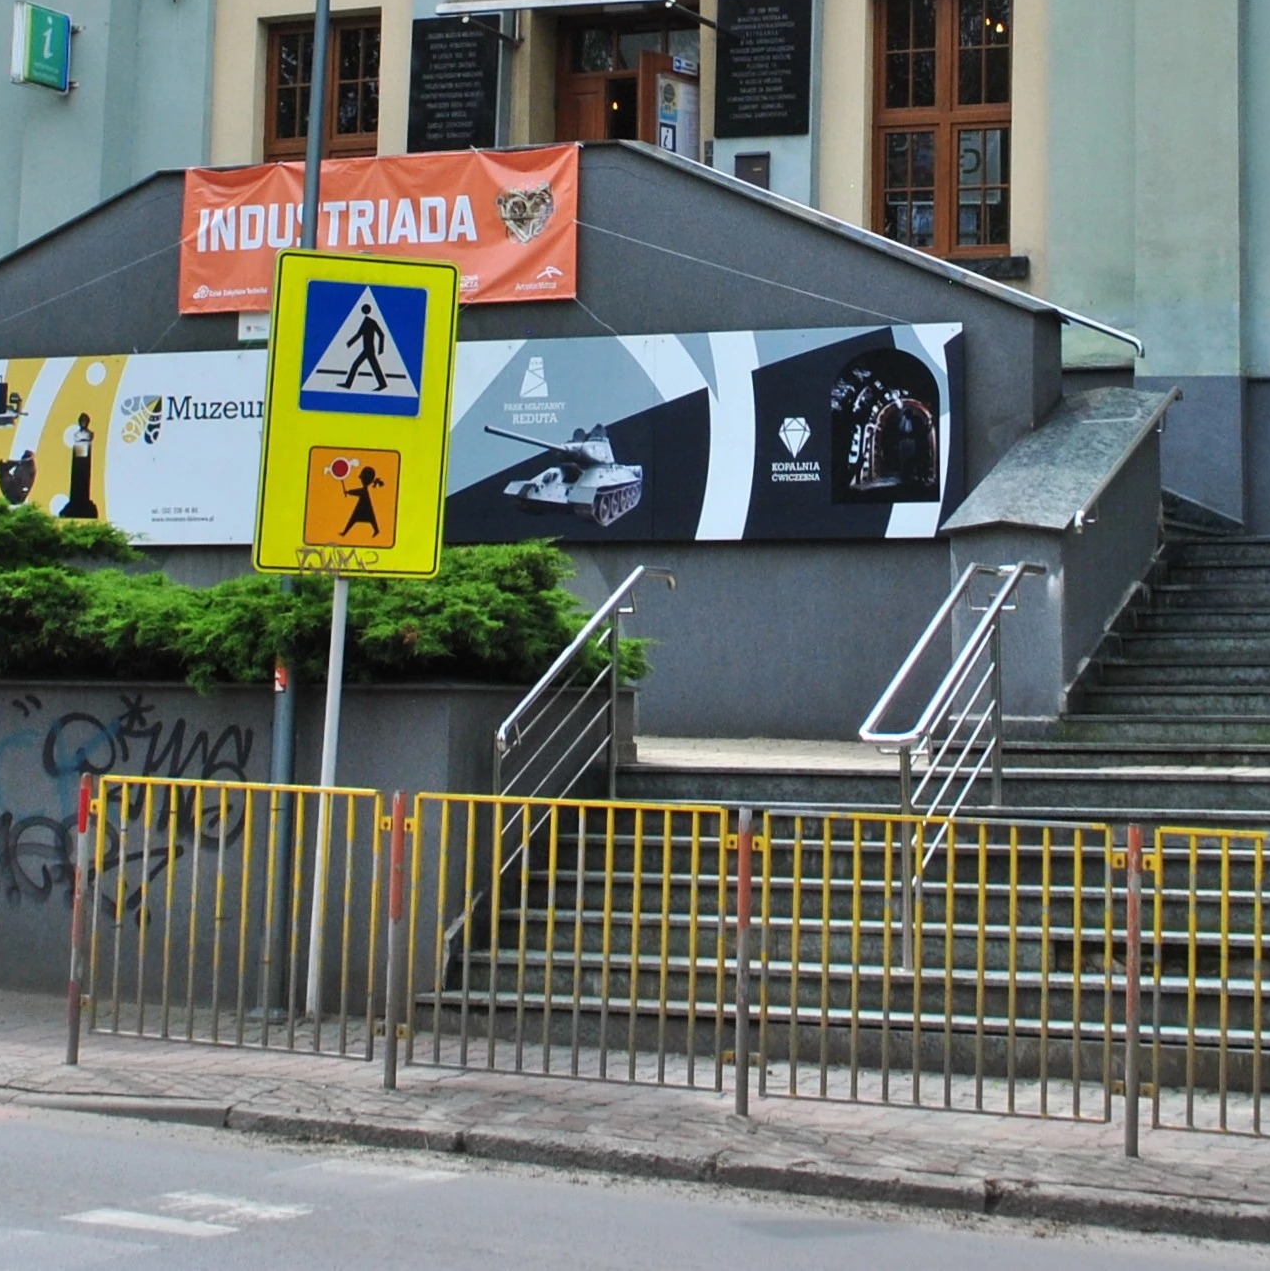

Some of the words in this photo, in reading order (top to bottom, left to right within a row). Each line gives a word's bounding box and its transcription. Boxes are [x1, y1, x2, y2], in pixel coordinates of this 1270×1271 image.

[197, 195, 478, 252] INDUTRIADA
[512, 413, 558, 425] REDUTA
[771, 461, 821, 471] KOPALNIA
